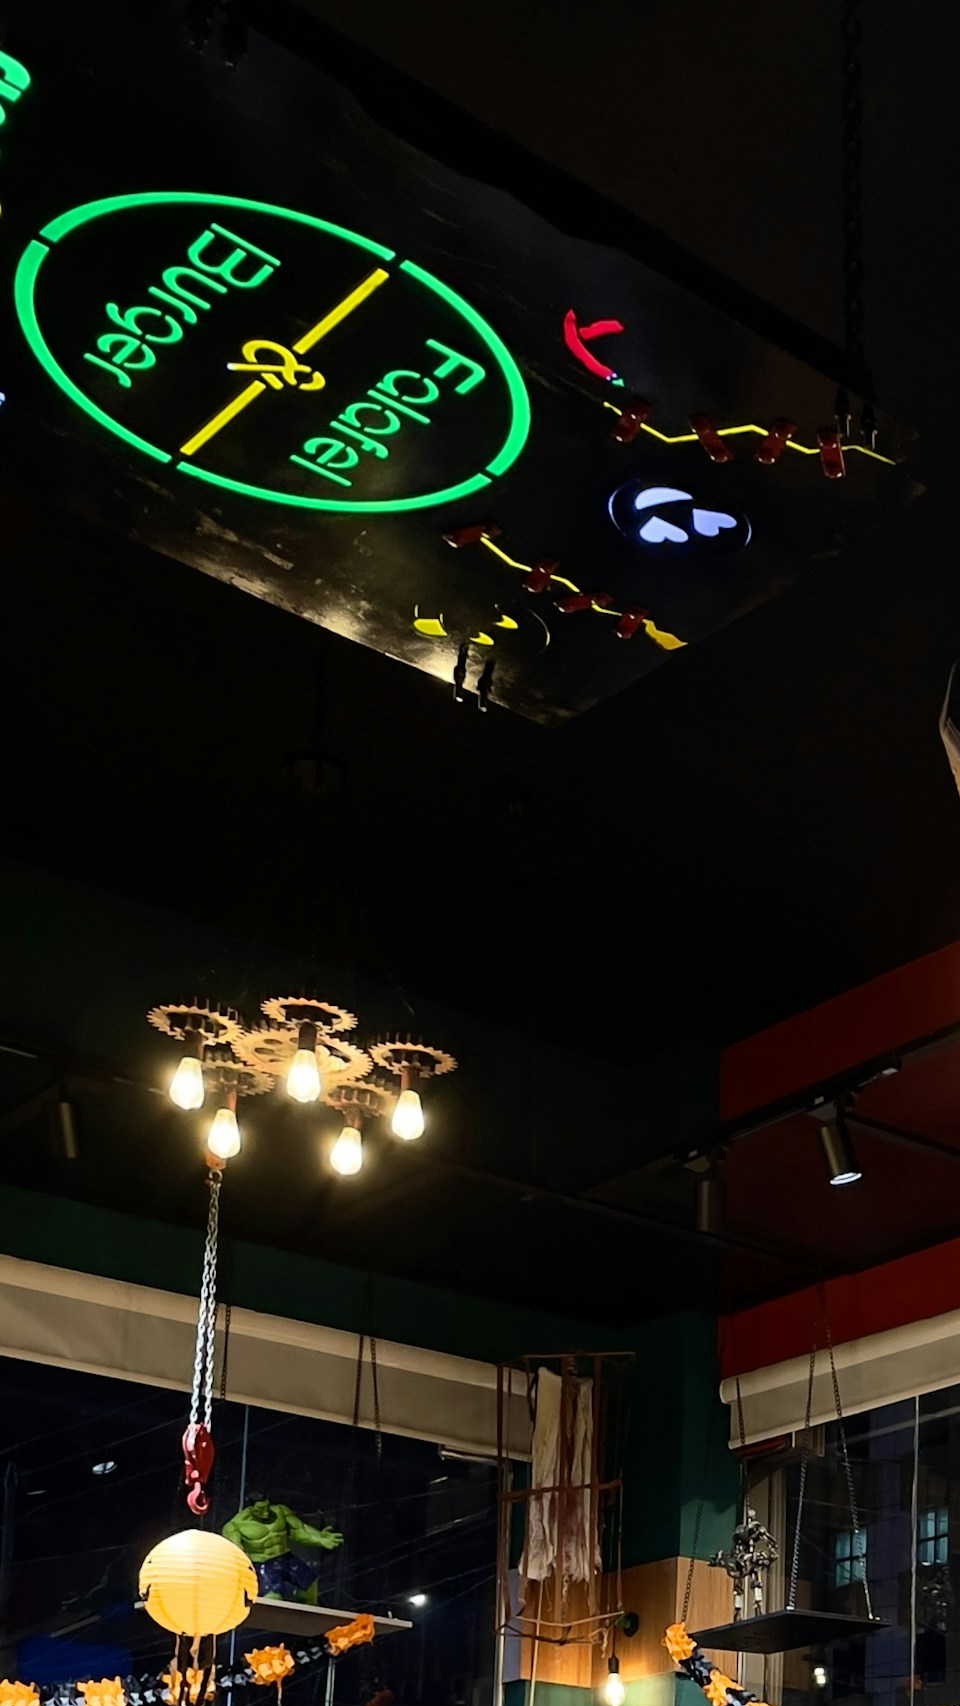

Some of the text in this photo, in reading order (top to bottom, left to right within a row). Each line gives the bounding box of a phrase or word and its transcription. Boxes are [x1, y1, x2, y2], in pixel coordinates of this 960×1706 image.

[83, 222, 282, 389] Burger
[226, 339, 326, 391] &
[289, 338, 487, 487] Falafel
